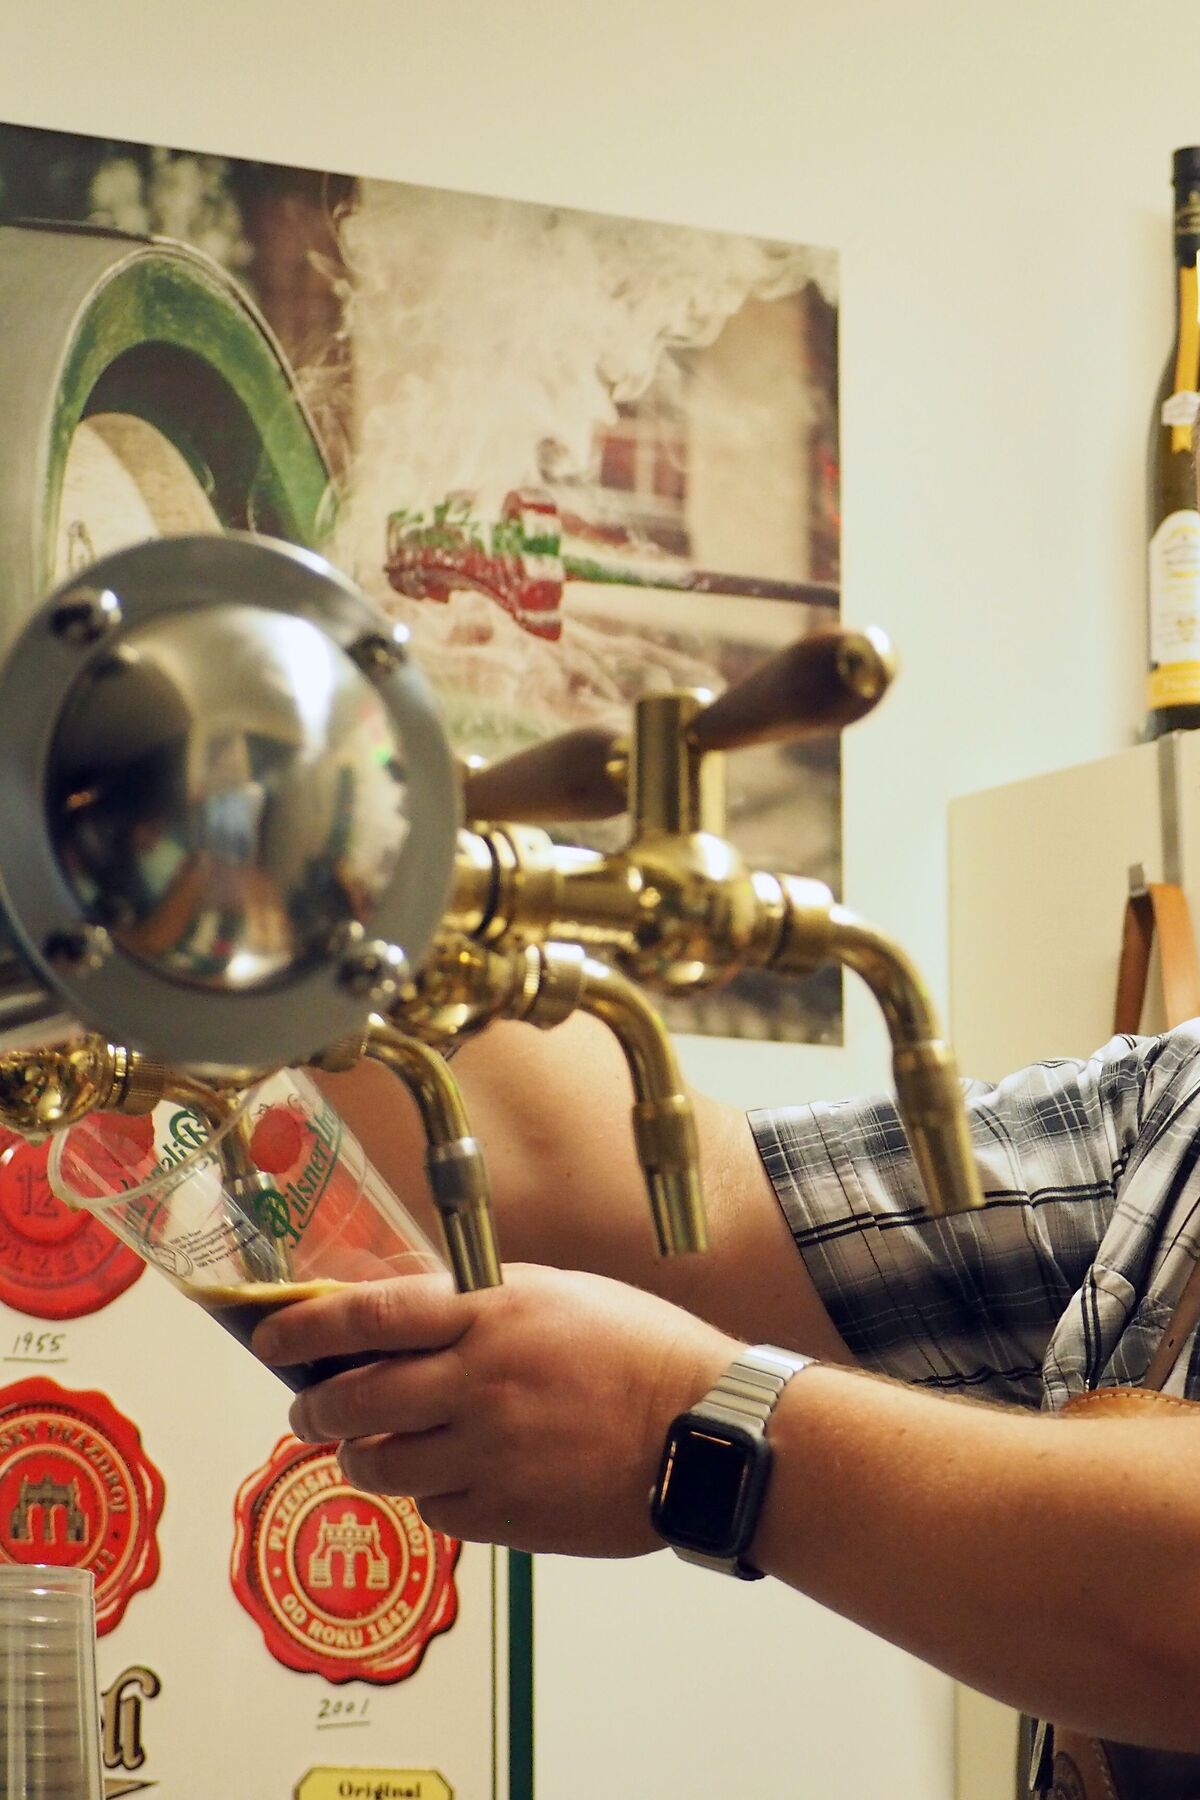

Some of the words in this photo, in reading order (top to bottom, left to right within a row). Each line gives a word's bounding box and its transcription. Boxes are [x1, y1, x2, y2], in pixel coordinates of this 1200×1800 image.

[253, 1138, 329, 1249] Pilsner
[13, 1331, 66, 1354] 1955
[281, 1592, 308, 1626] OD
[306, 1617, 364, 1649] ROKU
[318, 1698, 370, 1719] 2001
[339, 1779, 421, 1800] Original
